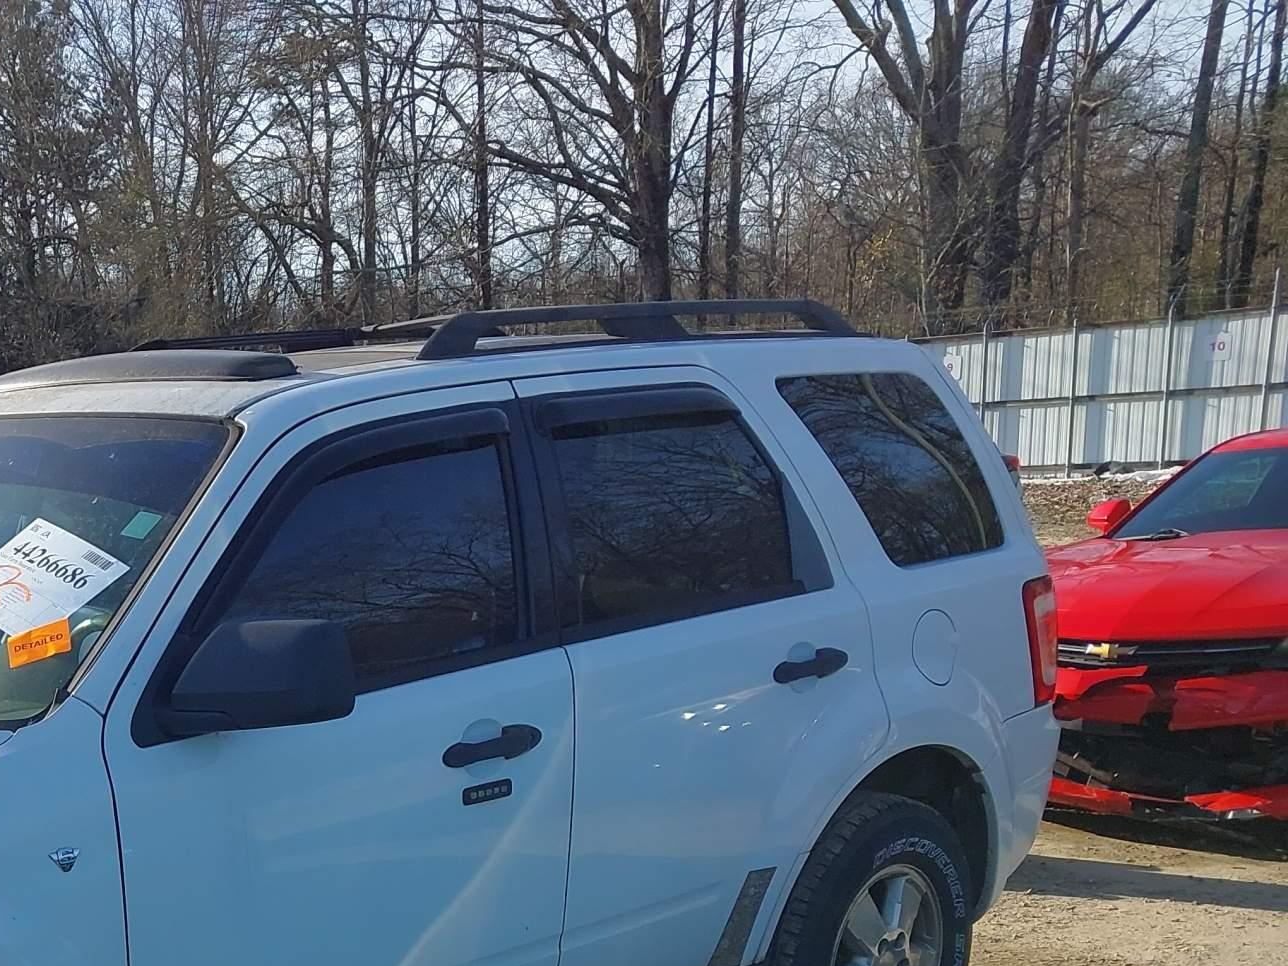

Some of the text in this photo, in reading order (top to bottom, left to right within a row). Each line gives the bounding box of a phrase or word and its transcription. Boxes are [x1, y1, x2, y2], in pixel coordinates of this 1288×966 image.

[1210, 342, 1225, 352] 10
[13, 541, 96, 590] 44266686
[14, 633, 63, 653] DETAILED
[872, 837, 966, 918] DISCOVERER
